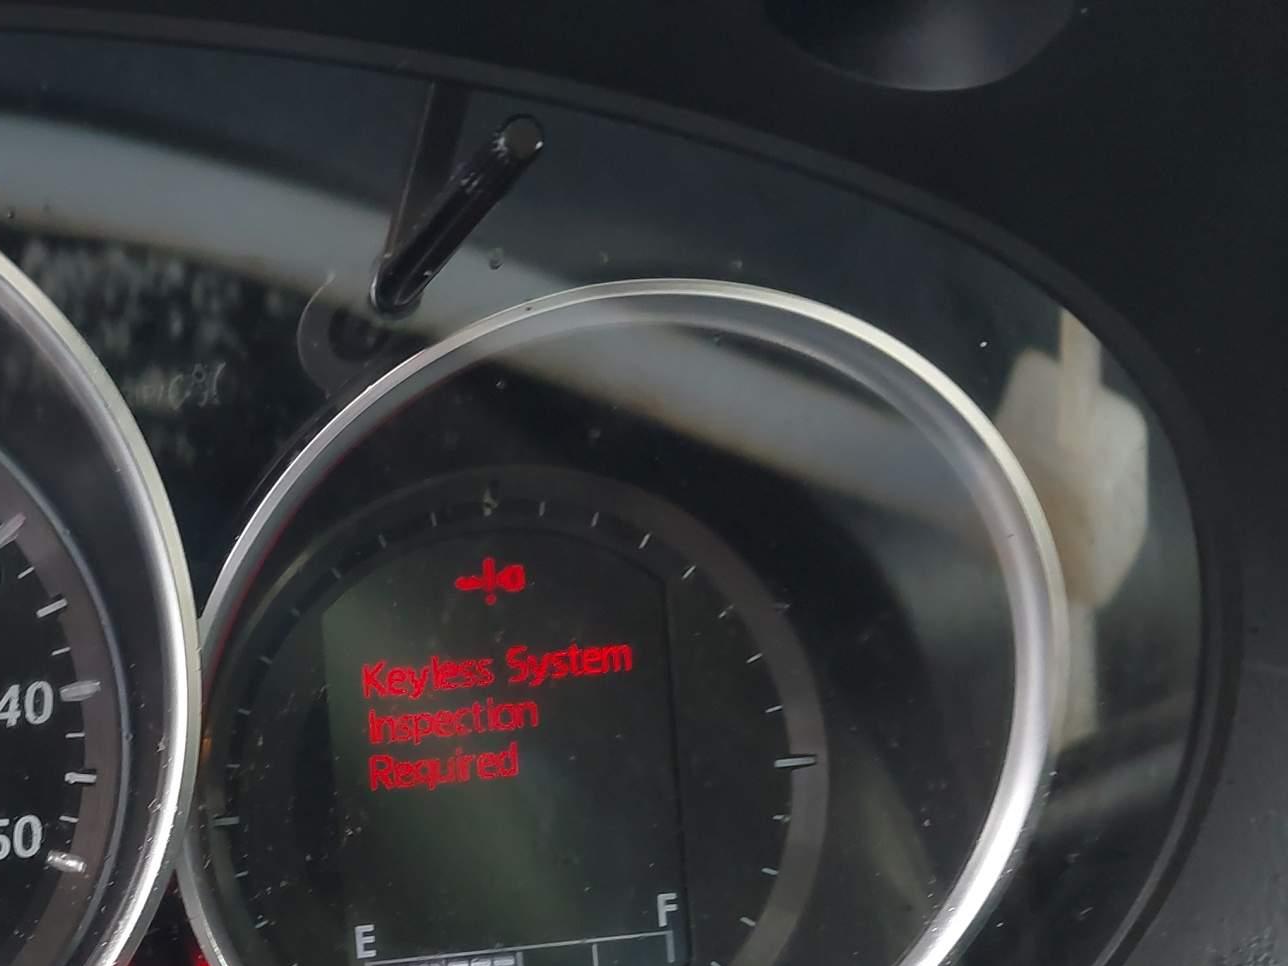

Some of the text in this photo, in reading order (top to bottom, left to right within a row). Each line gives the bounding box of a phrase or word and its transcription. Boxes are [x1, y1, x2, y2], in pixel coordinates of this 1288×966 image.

[362, 642, 633, 699] Keyless System
[368, 699, 540, 745] Inspection
[368, 740, 521, 792] Required
[656, 893, 679, 928] F
[354, 924, 378, 960] E
